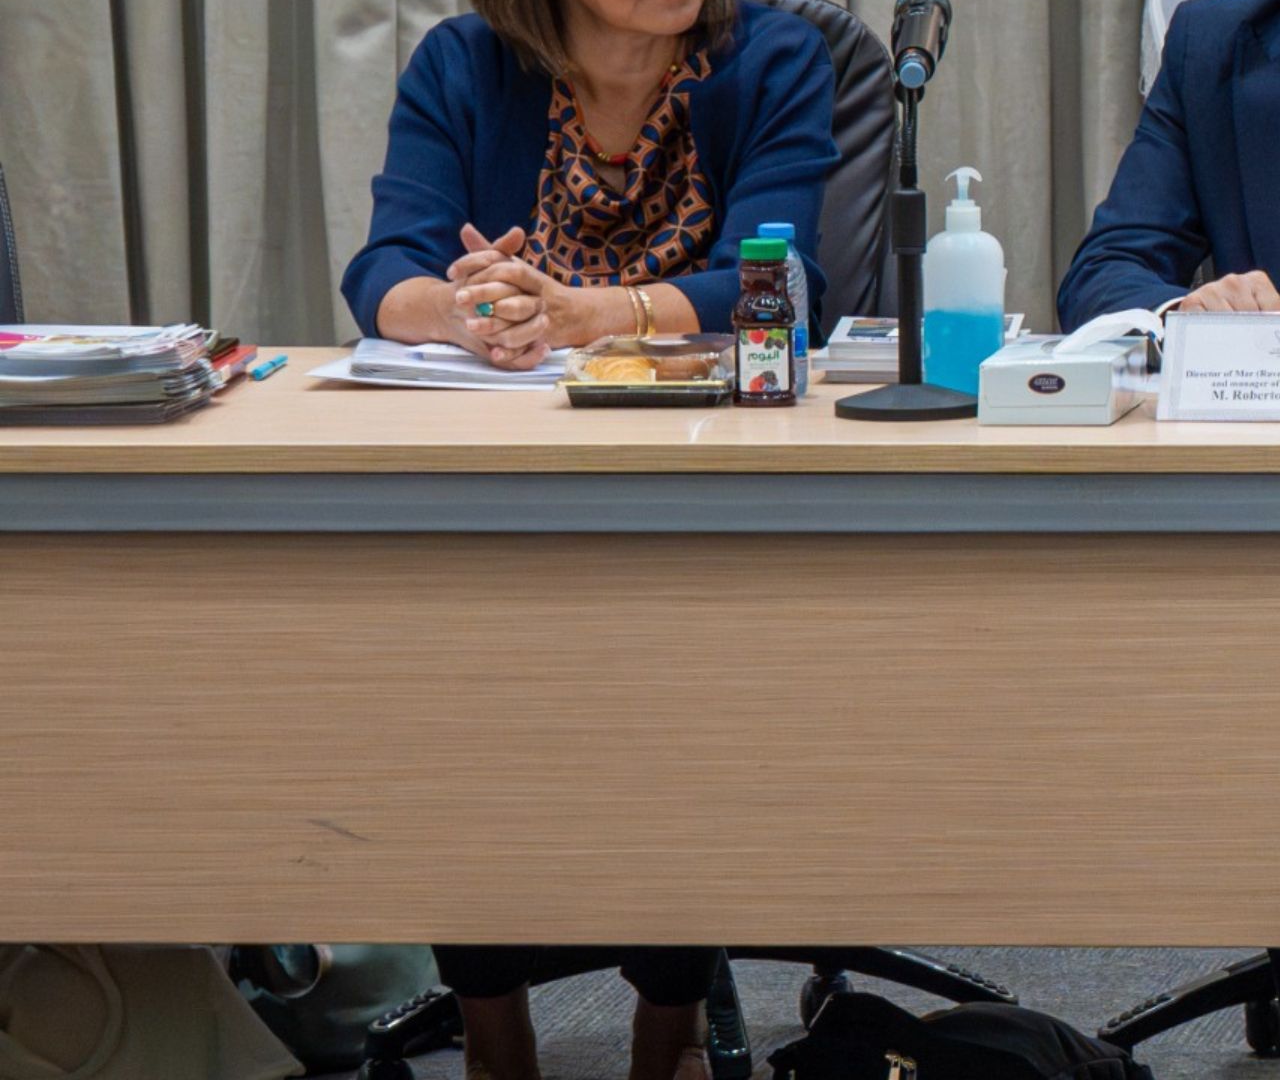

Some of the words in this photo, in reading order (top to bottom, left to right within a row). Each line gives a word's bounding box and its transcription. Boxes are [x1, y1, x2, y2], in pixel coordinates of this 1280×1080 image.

[1185, 369, 1221, 378] Director
[1223, 369, 1233, 378] of
[1212, 379, 1228, 387] and
[1229, 380, 1267, 389] manager
[1271, 379, 1280, 387] of
[1212, 389, 1229, 401] M.
